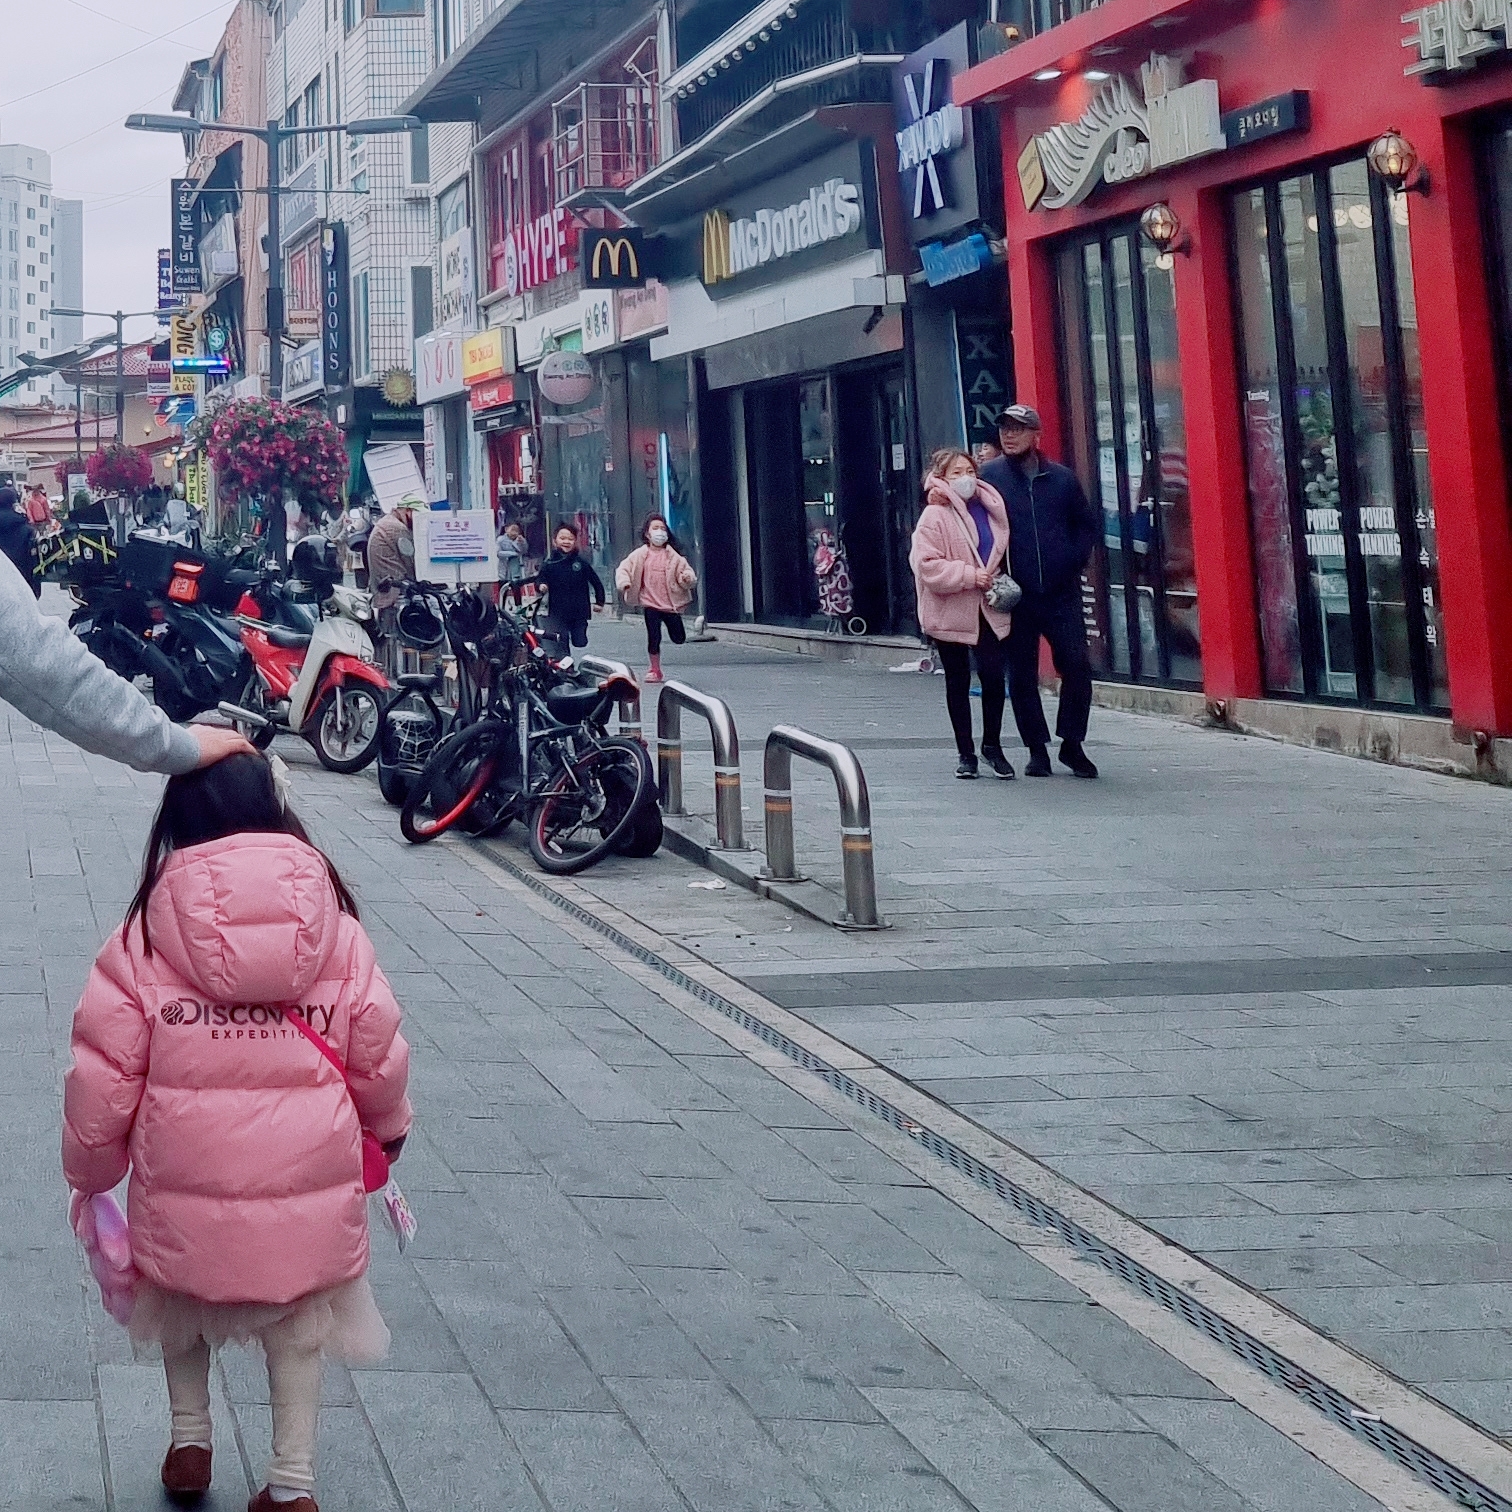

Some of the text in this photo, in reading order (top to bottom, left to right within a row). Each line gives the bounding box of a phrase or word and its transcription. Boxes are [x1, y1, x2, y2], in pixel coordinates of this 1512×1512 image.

[729, 178, 861, 274] McDonald's
[517, 208, 568, 293] HYPE
[327, 271, 339, 370] HOONS
[1305, 508, 1341, 530] POWER
[1359, 507, 1396, 529] POWER
[1304, 534, 1345, 556] TANNING
[1358, 533, 1402, 556] TANNING
[177, 997, 336, 1036] Discovery
[211, 1029, 306, 1040] EXPEDITIO
